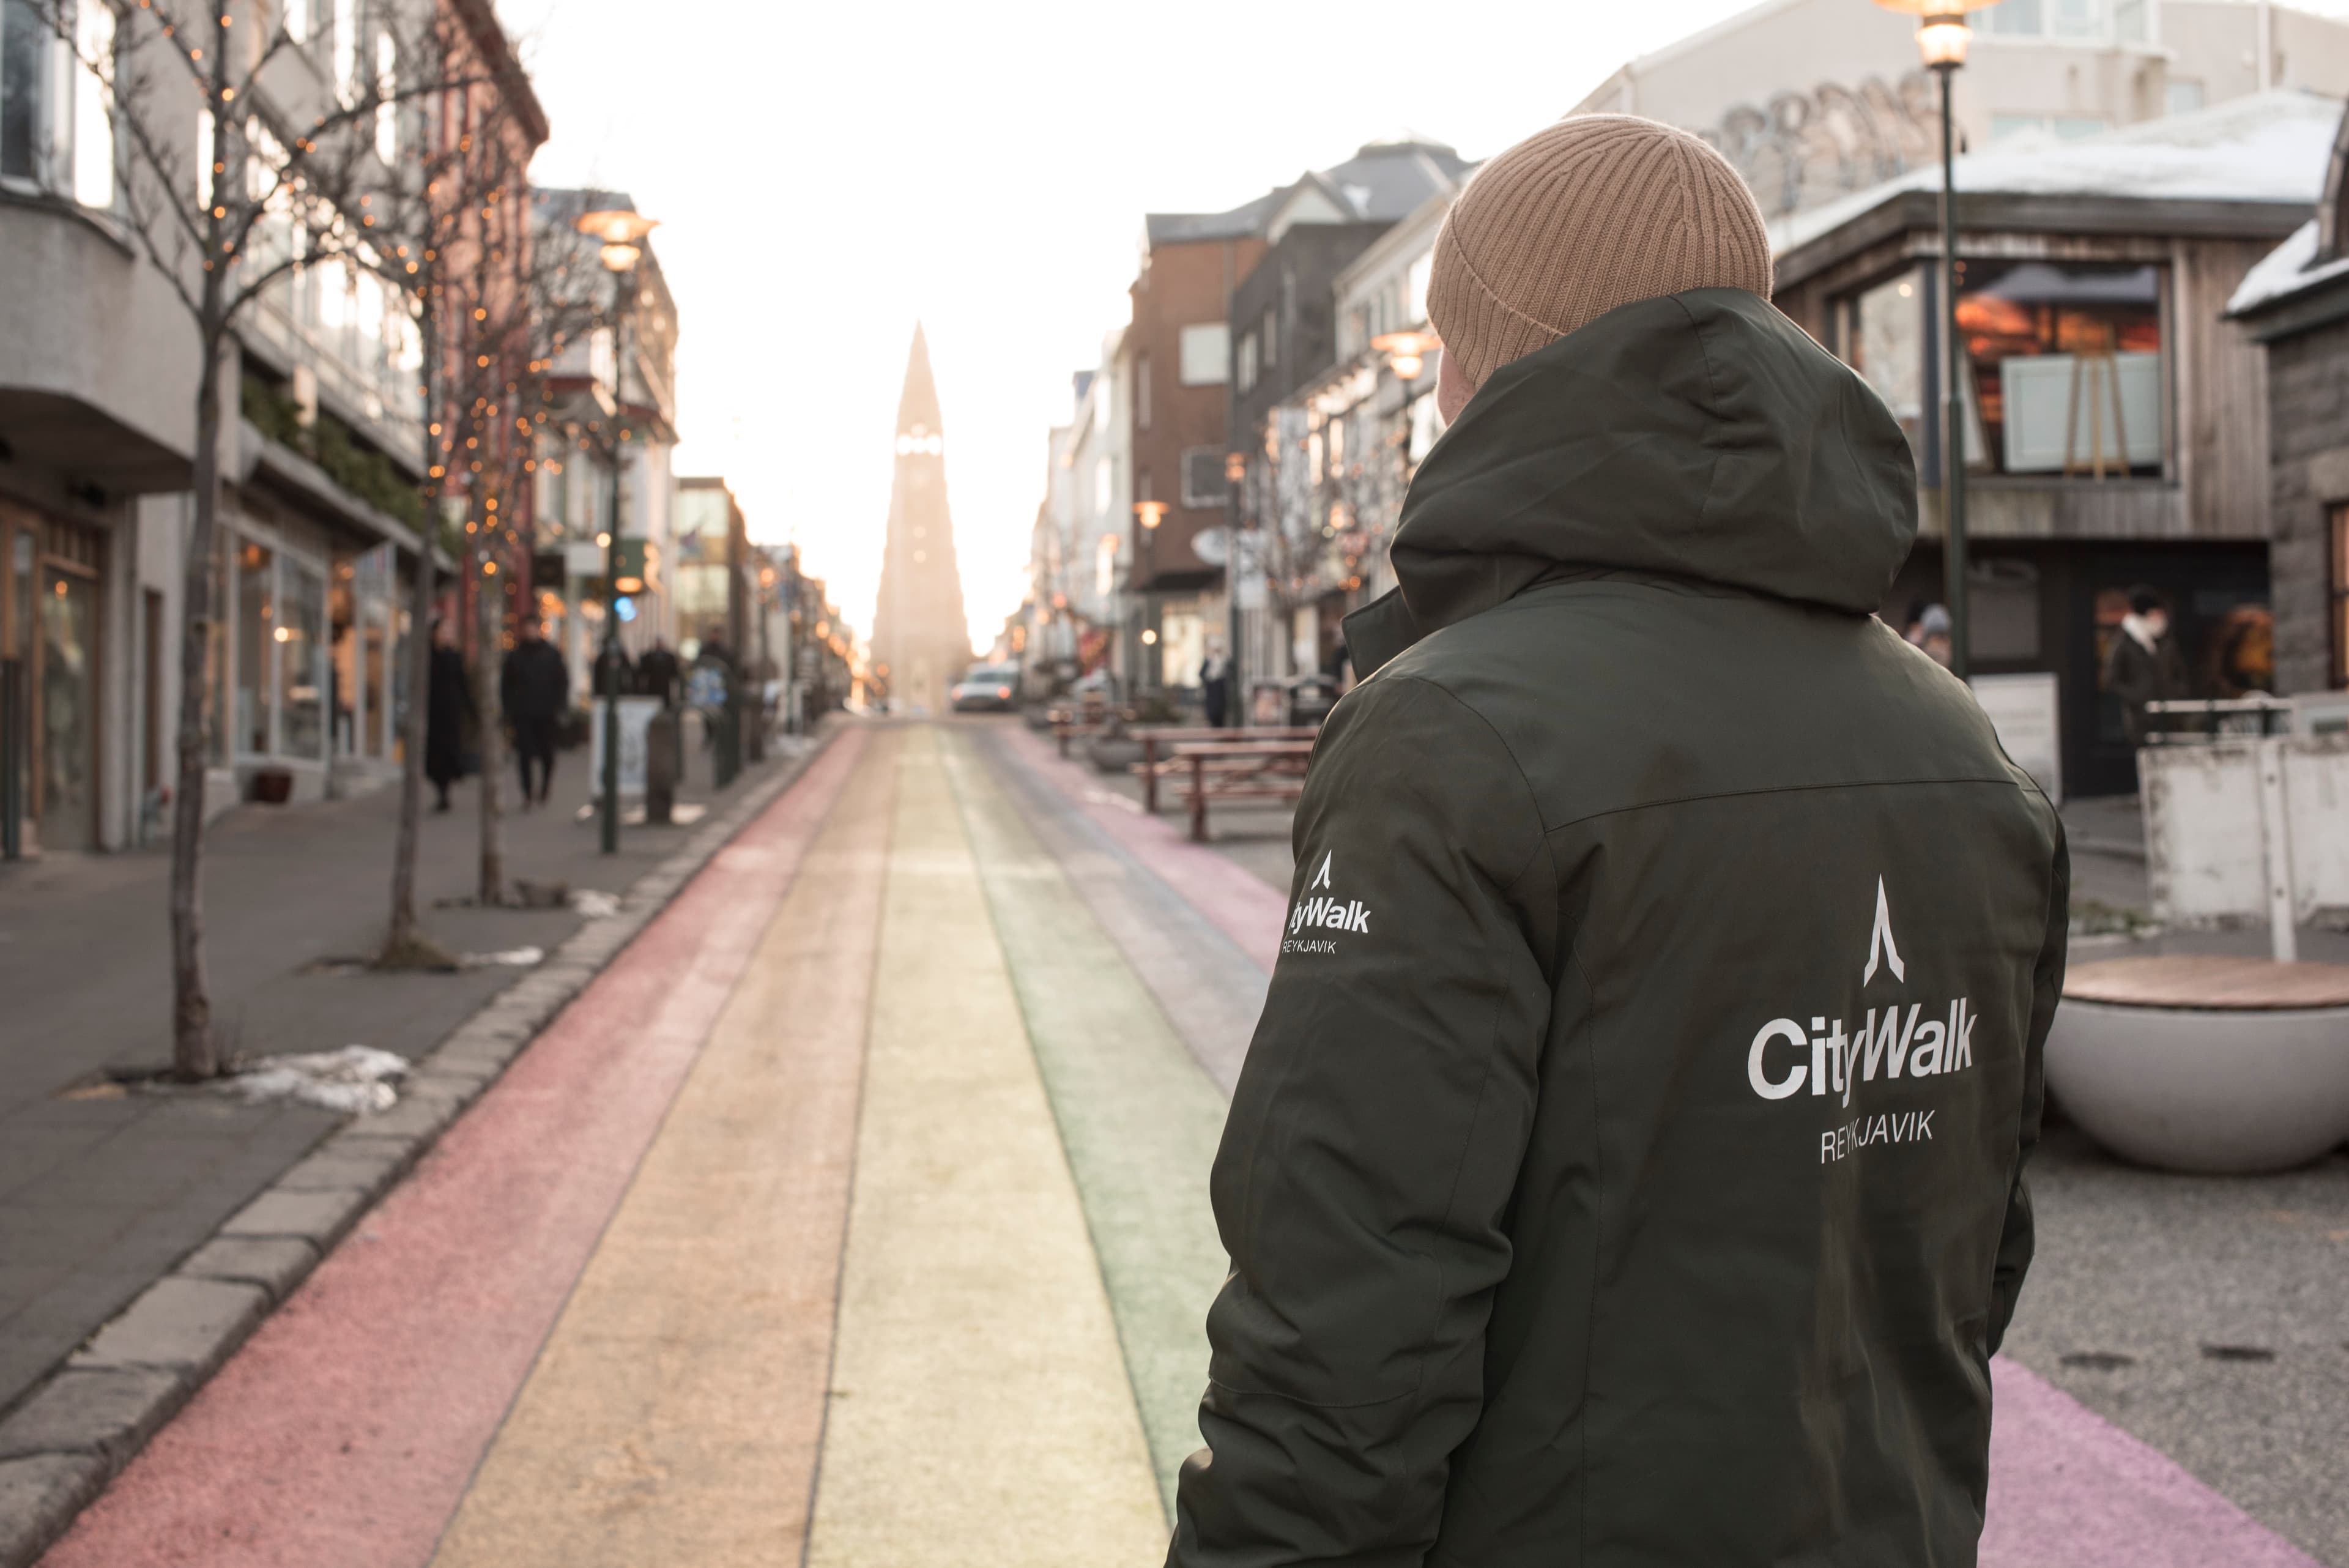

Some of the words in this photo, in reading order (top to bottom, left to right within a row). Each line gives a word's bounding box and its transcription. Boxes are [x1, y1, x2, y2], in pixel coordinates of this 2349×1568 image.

[1288, 896, 1371, 935] tyWalk
[1282, 939, 1337, 954] REYKJAVIK
[1748, 997, 1978, 1109] CityWalk
[1821, 1110, 1935, 1164] REYKJAVIK
